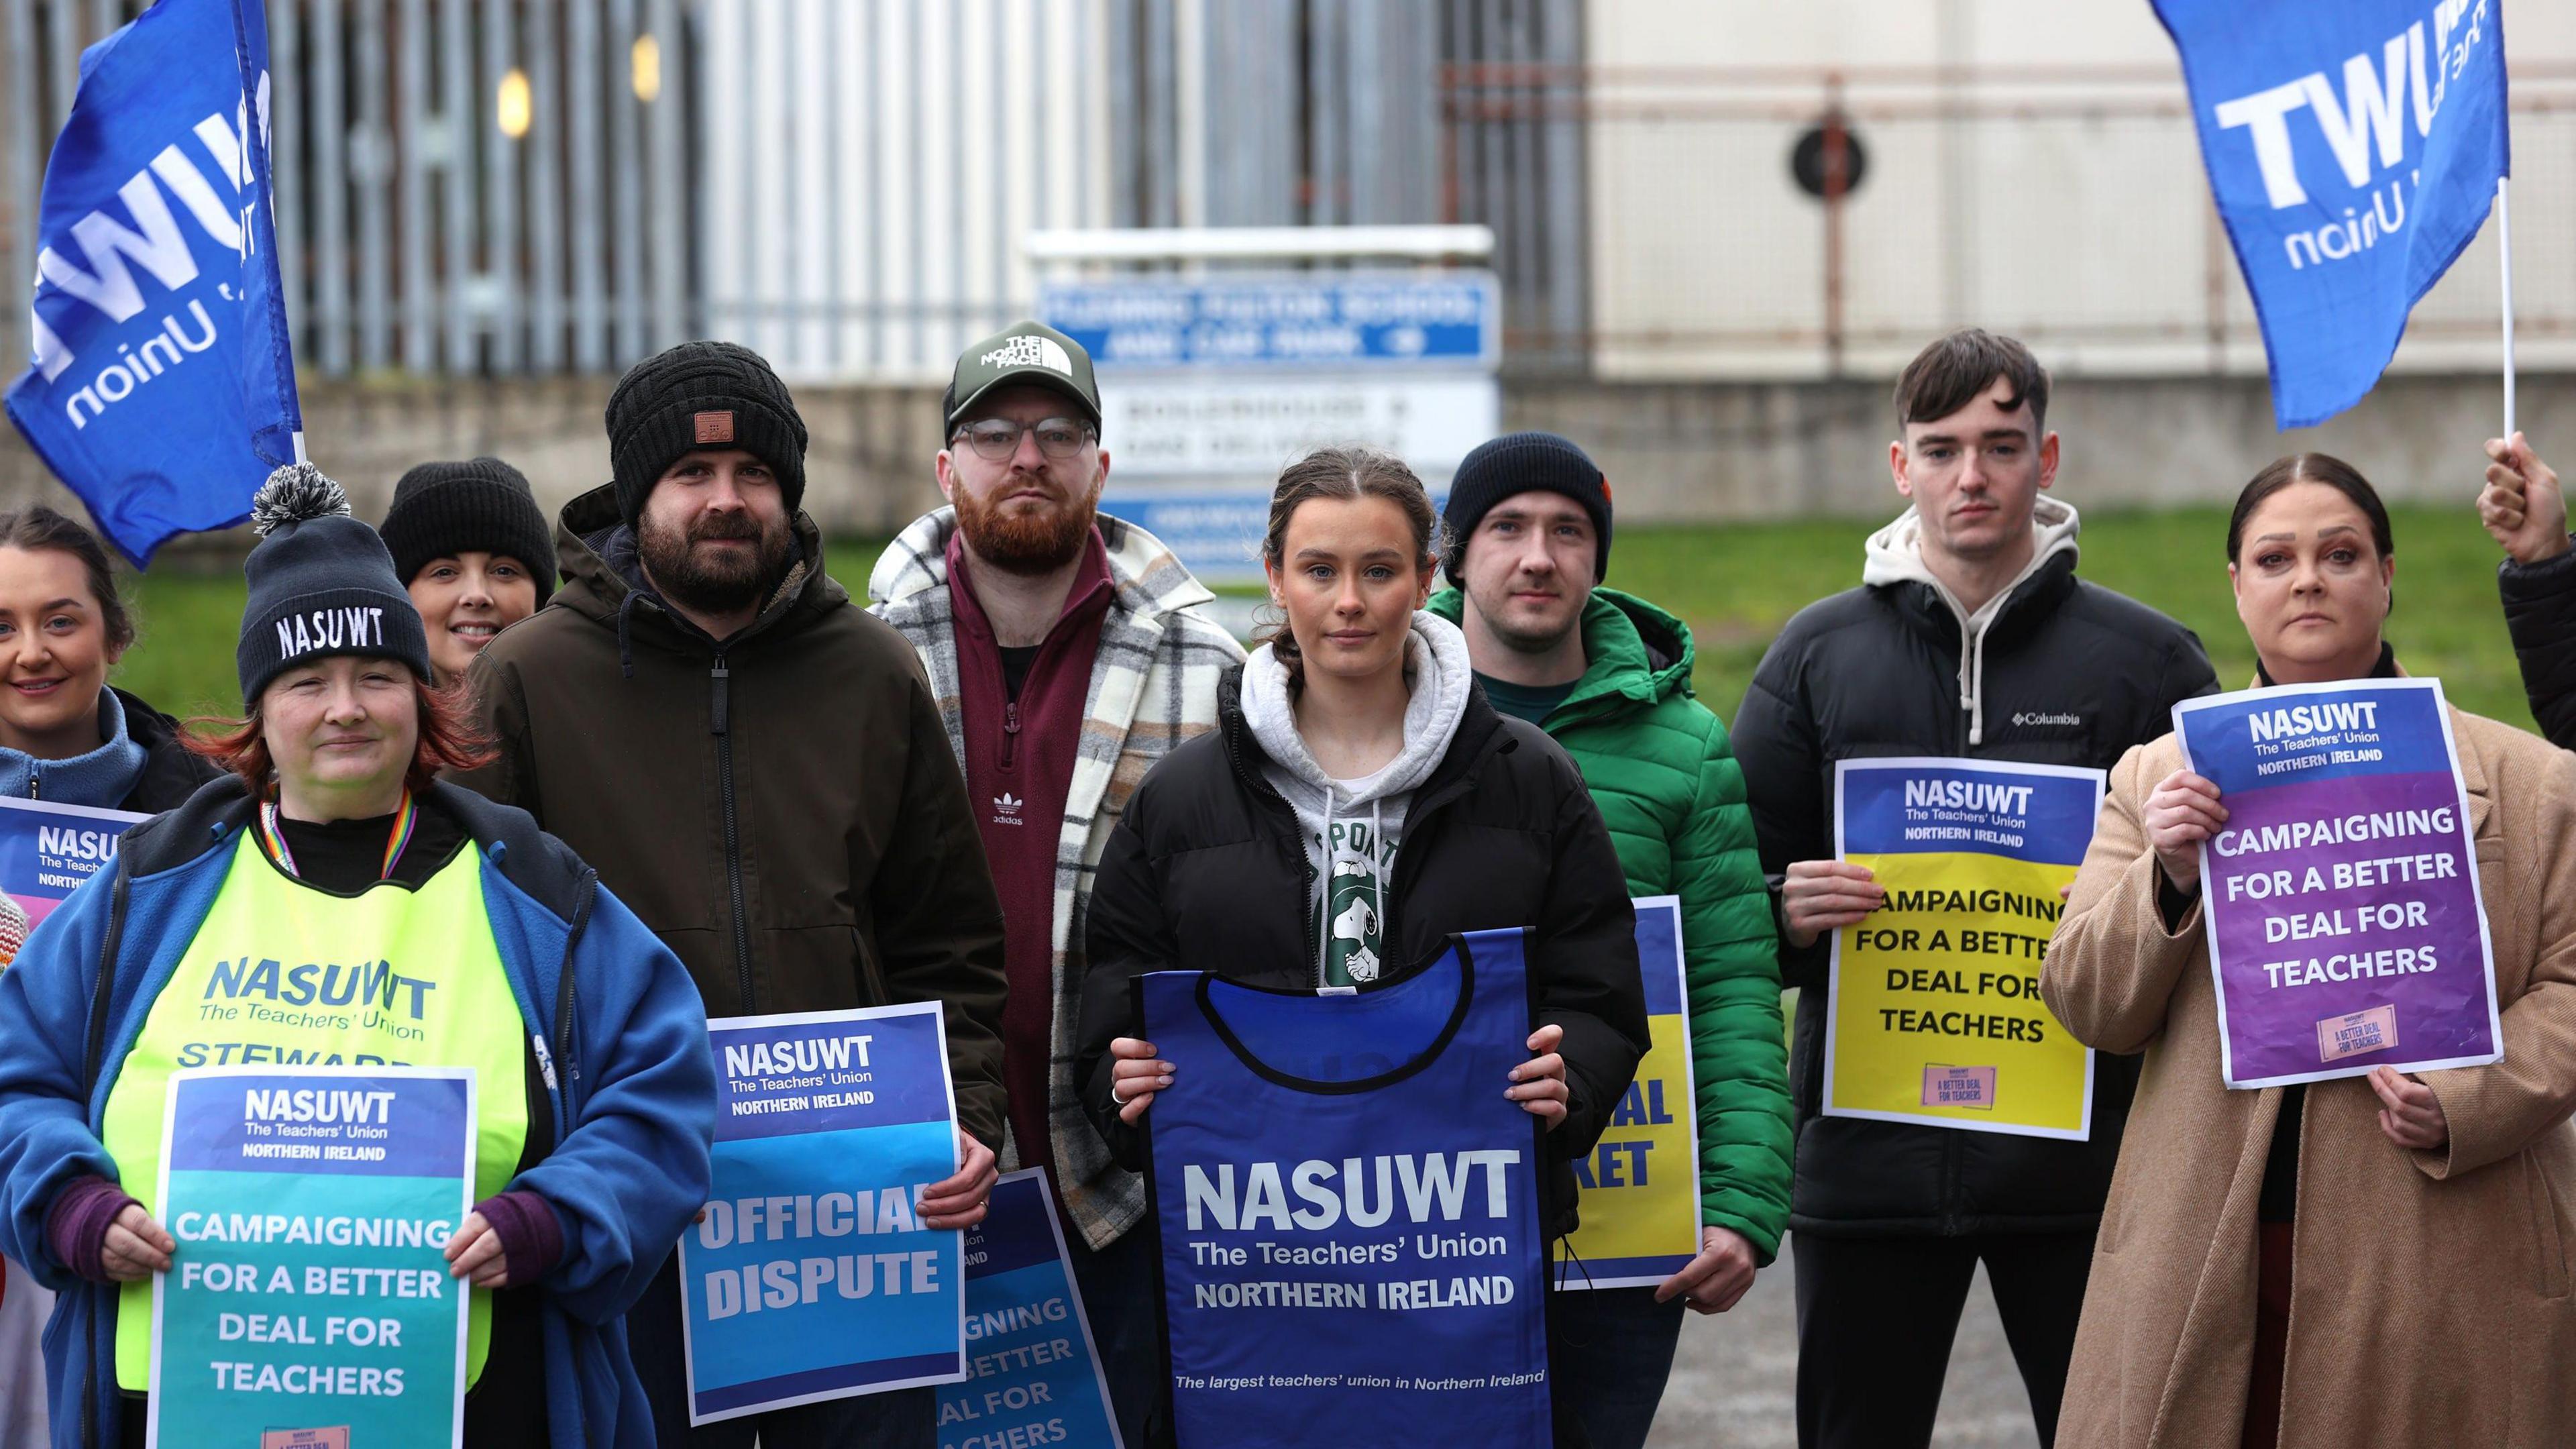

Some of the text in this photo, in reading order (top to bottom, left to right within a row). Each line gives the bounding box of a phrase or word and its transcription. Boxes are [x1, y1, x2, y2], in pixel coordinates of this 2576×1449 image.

[981, 345, 1040, 366] NORTH
[1006, 335, 1041, 348] THE
[997, 355, 1042, 368] FACE
[276, 606, 382, 659] NASUWT
[2025, 712, 2080, 725] Columbia
[2249, 702, 2377, 743] NASUWT
[2254, 743, 2279, 756] The
[2345, 731, 2379, 743] Union
[2257, 749, 2383, 775] NORTHERN IRELAND
[1906, 780, 2033, 815] NASUWT
[993, 815, 1023, 826] adidas
[1906, 808, 1929, 820] The
[1992, 814, 2026, 828] Union
[2214, 808, 2455, 857] CAMPAIGNING
[38, 826, 119, 863] NASU
[1905, 826, 2024, 848] NORTHERN IRELAND
[40, 855, 101, 873] The Teach
[2226, 853, 2457, 902] FOR A BETTER
[39, 873, 87, 889] NORTH
[1872, 890, 2066, 922] AMPAIGNIN
[2265, 901, 2428, 943] DEAL FOR
[1856, 930, 2050, 960] FOR A BETTE
[2263, 946, 2438, 989] TEACHERS
[204, 957, 436, 1020] NASUWT
[1886, 969, 2041, 1000] DEAL FOR
[200, 1004, 237, 1021] The
[363, 1011, 424, 1041] Union
[1879, 1009, 2043, 1042] TEACHERS
[2340, 1026, 2363, 1041] BETTER
[2364, 1021, 2381, 1035] DEAL
[725, 1035, 872, 1078] NASUWT
[2338, 1033, 2383, 1053] FOR TEACHERS
[729, 1080, 756, 1093] The
[830, 1071, 872, 1085] Union
[1939, 1089, 1981, 1101] FOR TEACHERS
[1943, 1079, 1965, 1090] BETTER
[1966, 1079, 1980, 1089] DEAL
[244, 1089, 395, 1124] NASUWT
[732, 1091, 874, 1116] NORTHERN IRELAND
[245, 1122, 271, 1136] The
[347, 1125, 388, 1139] Union
[242, 1143, 386, 1161] NORTHERN IRELAND
[1572, 1140, 1654, 1189] KET
[1183, 1149, 1520, 1230] NASUWT
[176, 1212, 451, 1249] CAMPAIGNING
[964, 1233, 984, 1246] ion
[1189, 1242, 1247, 1265] The
[1416, 1232, 1507, 1258] Union
[182, 1263, 441, 1298] FOR A BETTER
[705, 1250, 939, 1320] DISPUTE
[1195, 1275, 1514, 1309] NORTHERN IRELAND
[219, 1312, 402, 1347] DEAL FOR
[211, 1361, 405, 1397] TEACHERS
[1175, 1375, 1205, 1389] The
[1209, 1375, 1264, 1390] largest
[1347, 1375, 1391, 1388] union
[1395, 1377, 1409, 1389] in
[1414, 1377, 1485, 1391] Northern
[1490, 1369, 1545, 1388] Ireland
[937, 1381, 1053, 1426] AL FOR
[944, 1417, 1067, 1449] CHERS
